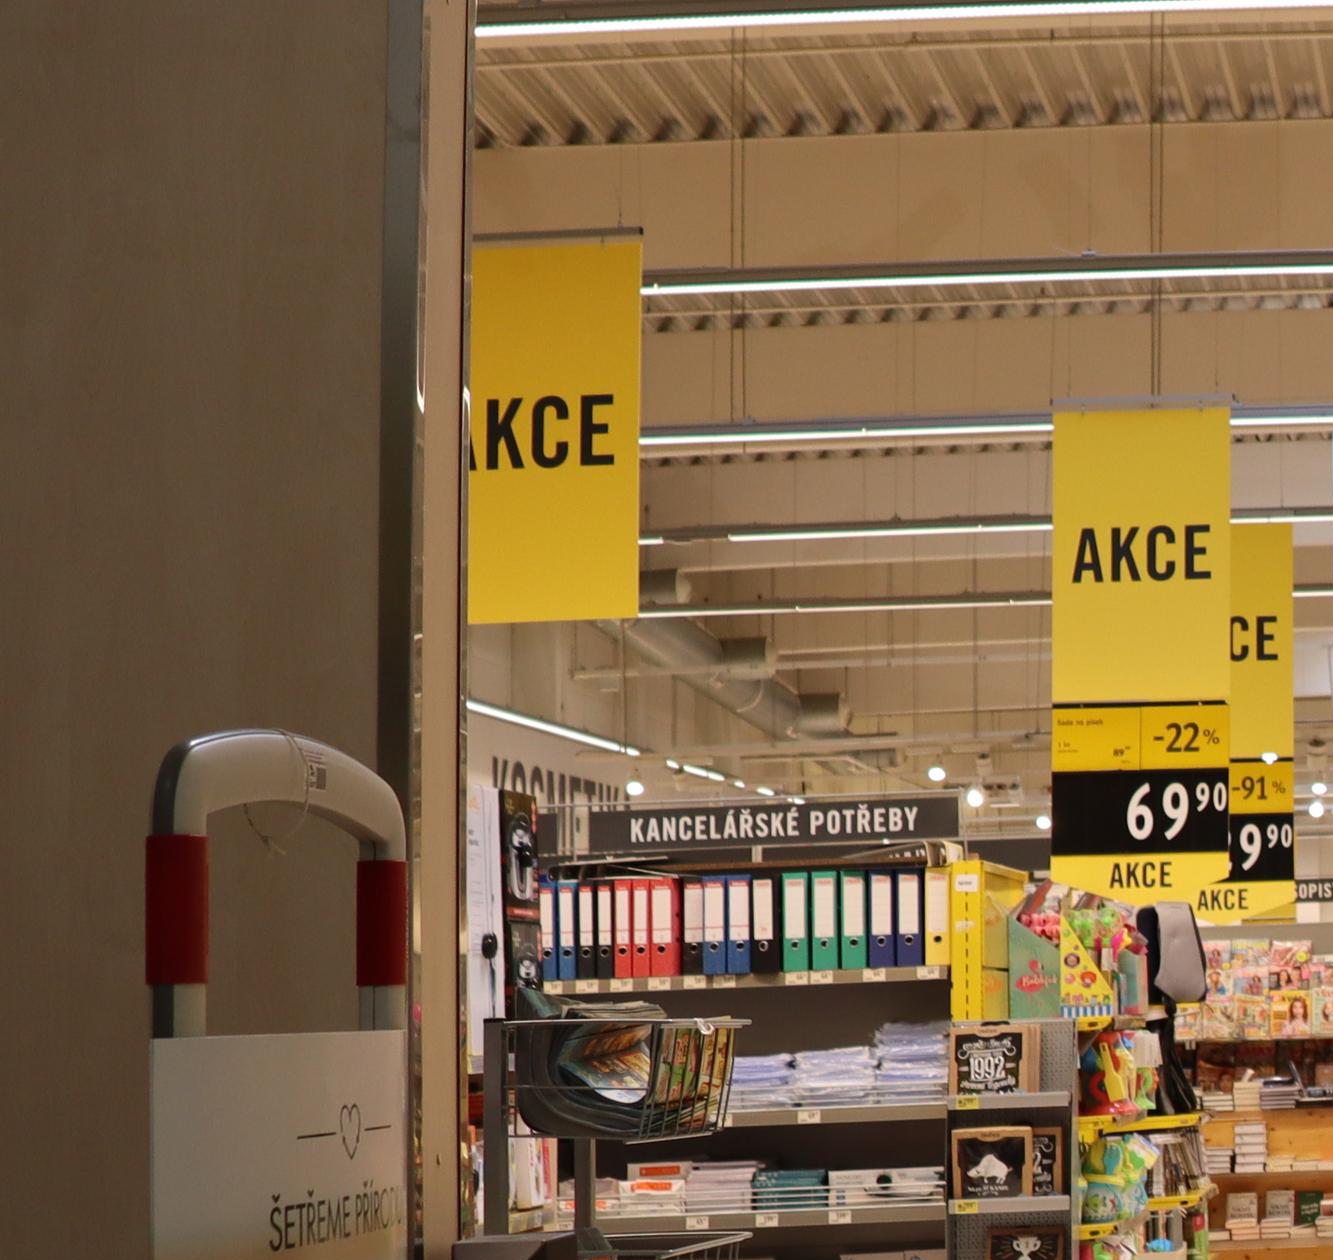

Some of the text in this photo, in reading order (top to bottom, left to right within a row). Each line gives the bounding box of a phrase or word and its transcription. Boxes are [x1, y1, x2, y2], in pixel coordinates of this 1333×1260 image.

[469, 394, 615, 472] KCE
[1072, 524, 1213, 584] AKCE
[630, 804, 918, 844] KANCELÁŘSKÉ POTŘEBY
[1110, 862, 1172, 889] AKCE
[1197, 889, 1248, 911] AKCE
[269, 1189, 351, 1252] ŠETŘEME
